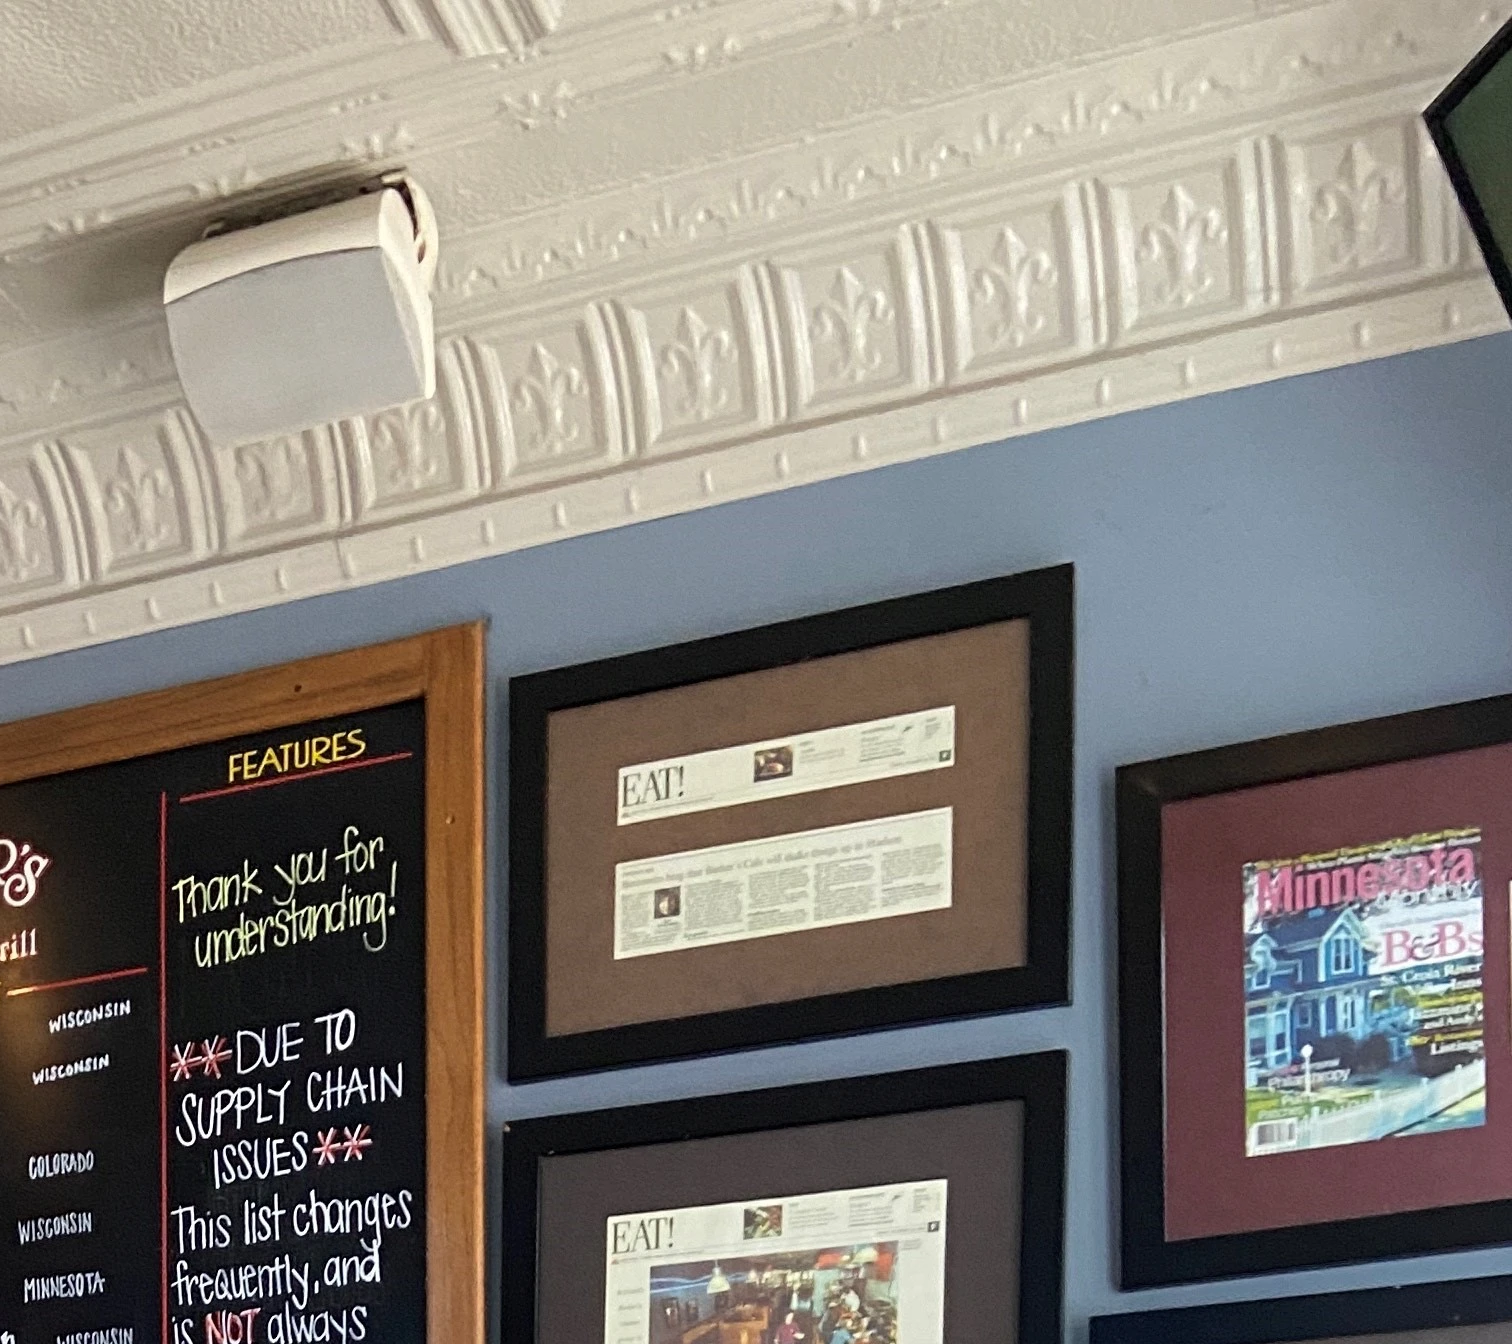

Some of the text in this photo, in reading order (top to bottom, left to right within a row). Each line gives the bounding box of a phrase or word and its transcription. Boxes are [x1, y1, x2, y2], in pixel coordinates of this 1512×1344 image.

[228, 728, 366, 783] FEATURES
[622, 765, 684, 808] EAT!
[172, 826, 384, 923] Thank you for
[1257, 846, 1475, 917] Minnesota
[195, 860, 398, 967] understanding!
[1382, 920, 1483, 967] B&Bs
[49, 1000, 131, 1034] WISCONSIN
[314, 1008, 356, 1055] TO
[32, 1054, 110, 1085] WISCONSIN
[175, 1062, 403, 1148] SUPPLY CHAIN
[29, 1150, 94, 1180] COLORADO
[18, 1212, 92, 1245] WISCONSIN
[171, 1189, 413, 1254] This list changes
[612, 1217, 674, 1255] EAT!
[24, 1271, 105, 1303] MINNESOTA
[323, 1250, 381, 1288] and
